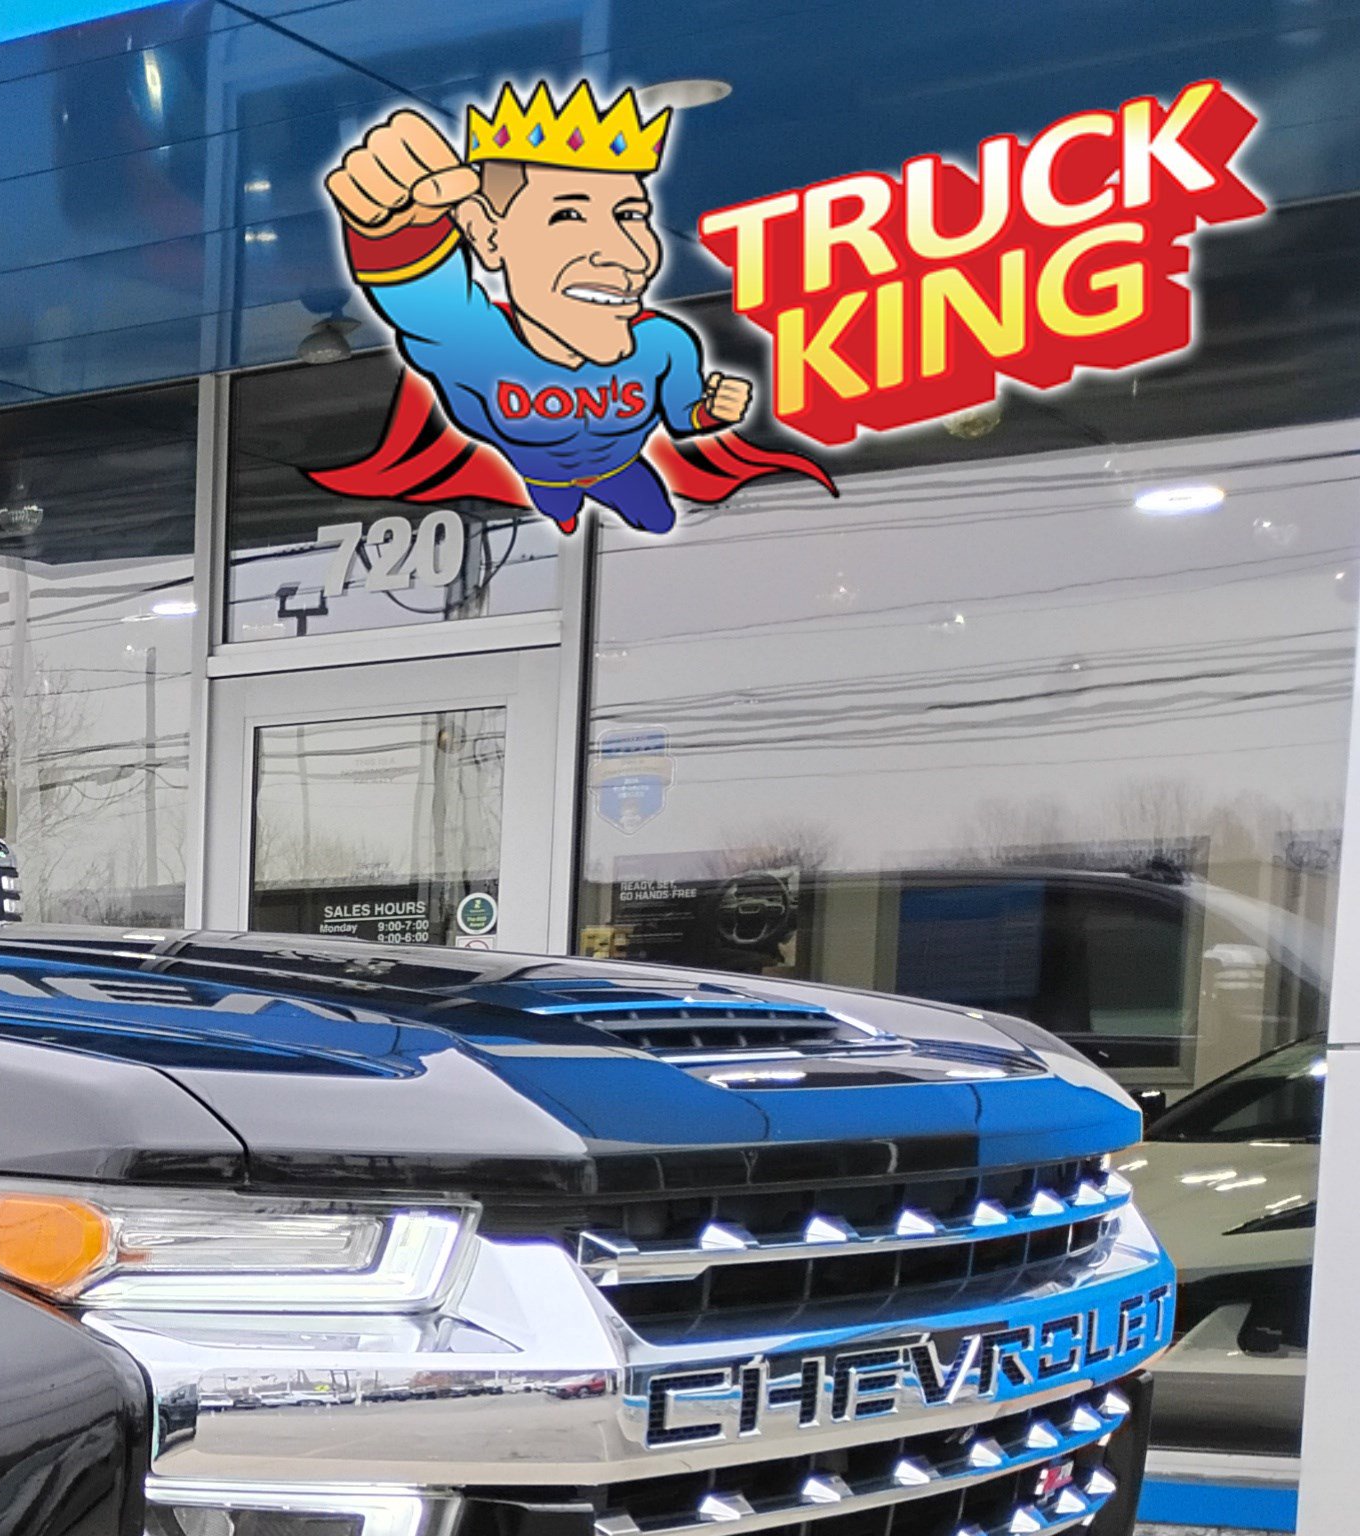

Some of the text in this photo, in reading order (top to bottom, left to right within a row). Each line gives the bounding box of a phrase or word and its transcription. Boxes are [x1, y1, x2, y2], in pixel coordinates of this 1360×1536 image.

[316, 509, 465, 598] 720
[320, 920, 430, 934] Monday 9:00-7:00
[324, 901, 427, 919] SALES HOURS
[645, 1285, 1172, 1450] CHEVROLET
